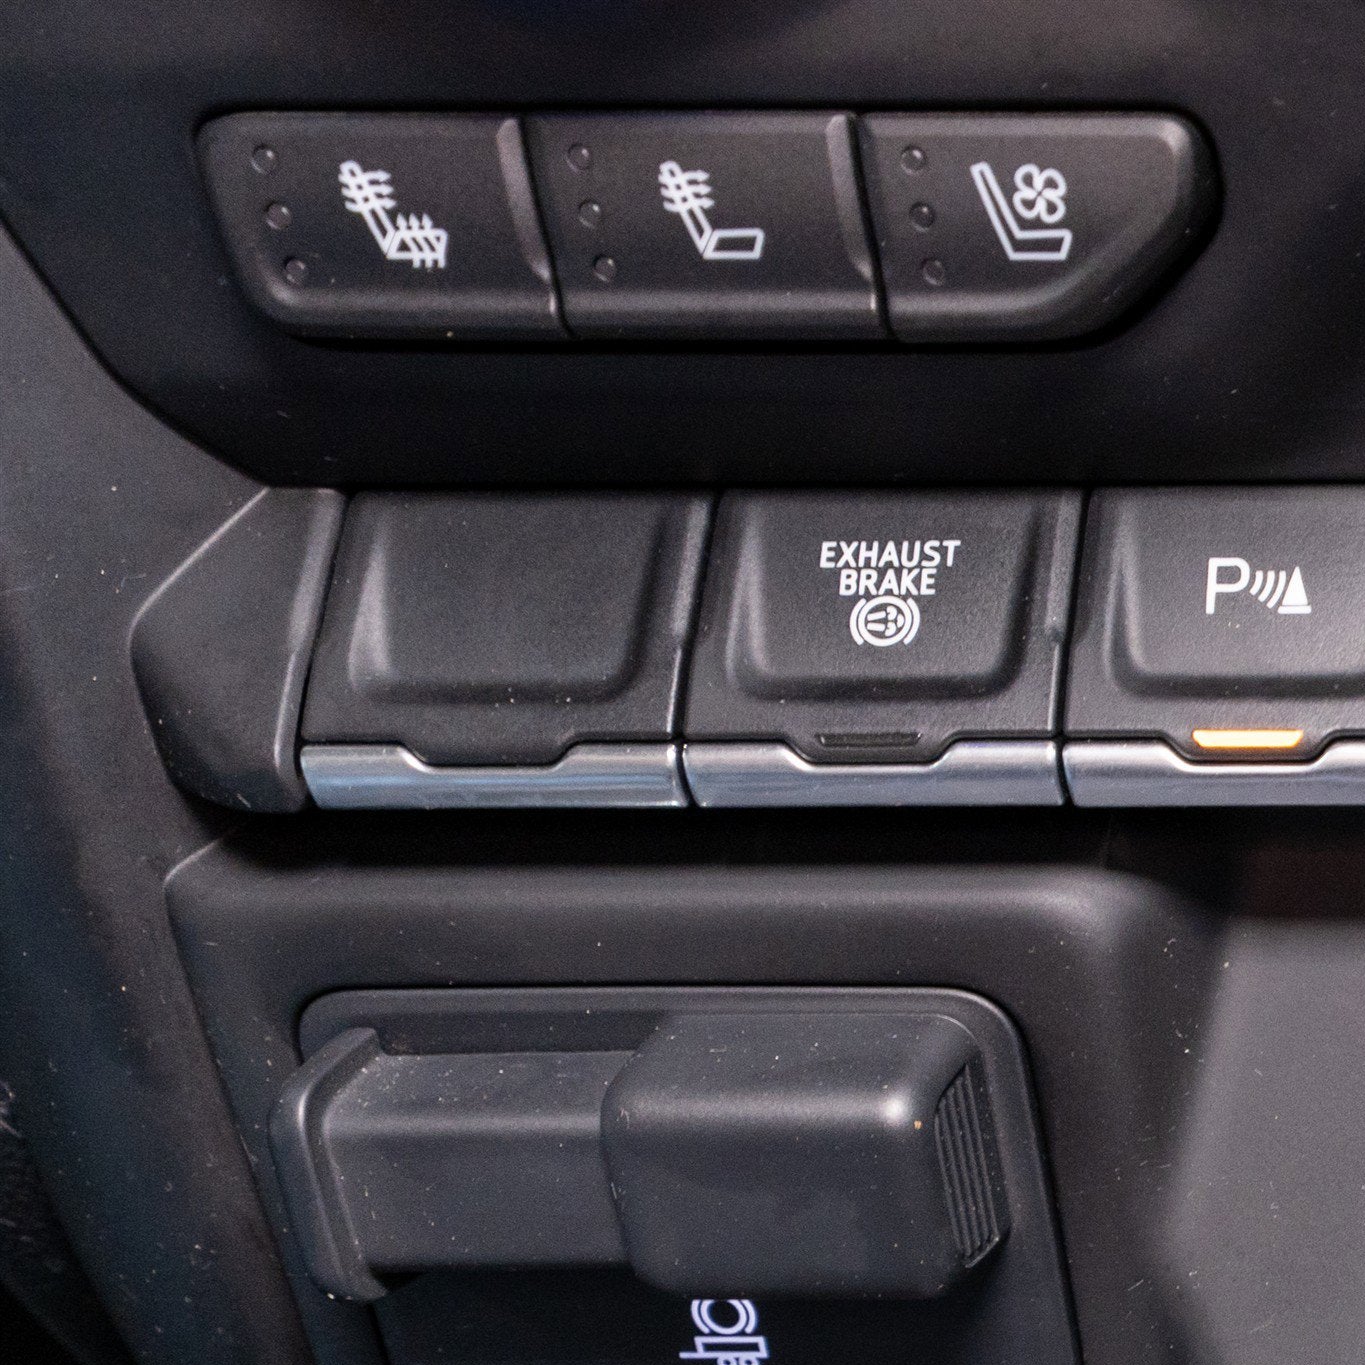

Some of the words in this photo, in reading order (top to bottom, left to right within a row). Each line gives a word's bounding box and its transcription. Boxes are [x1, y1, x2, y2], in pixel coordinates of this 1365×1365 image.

[819, 540, 962, 568] EXHAUST
[838, 568, 936, 597] BRAKE
[1205, 557, 1250, 615] P
